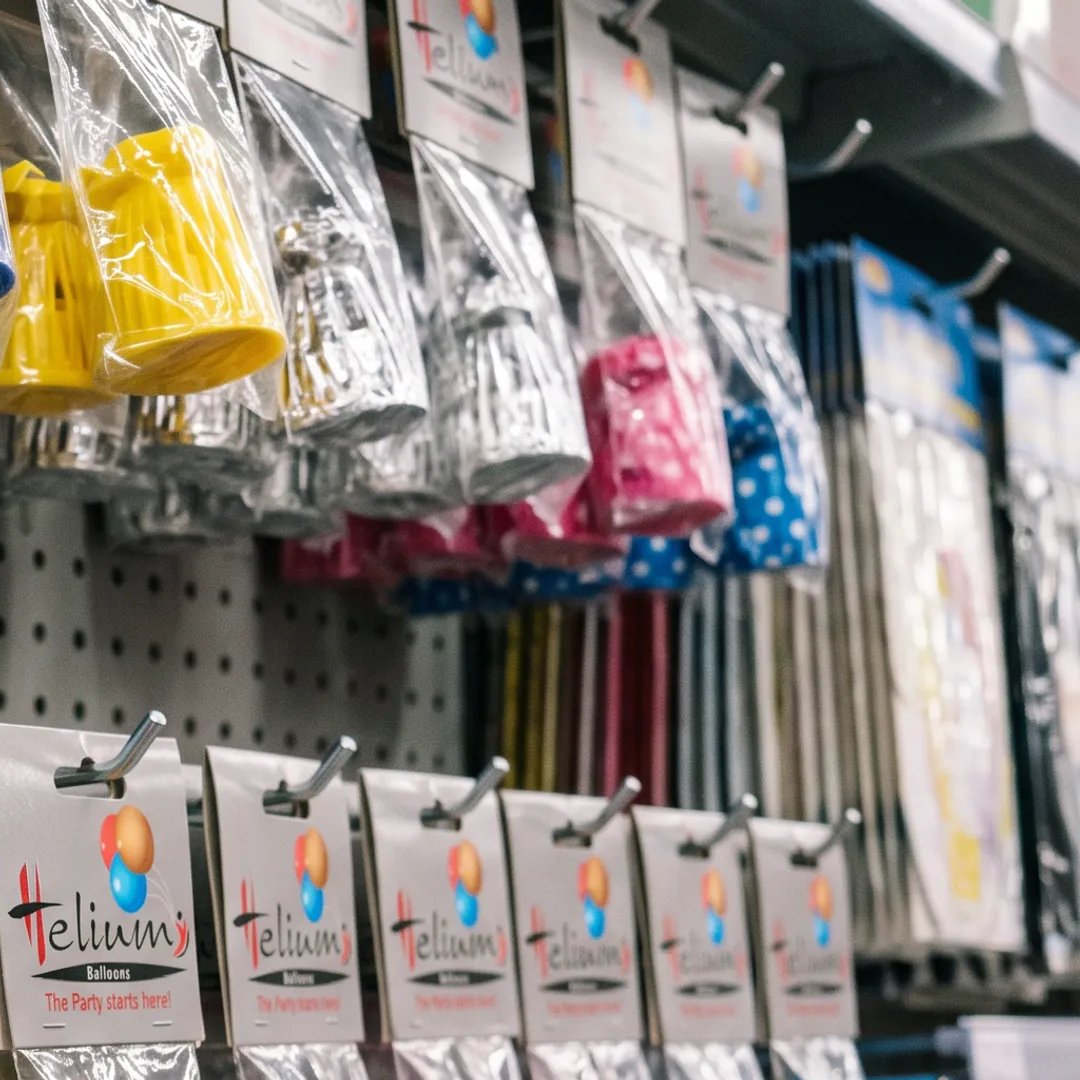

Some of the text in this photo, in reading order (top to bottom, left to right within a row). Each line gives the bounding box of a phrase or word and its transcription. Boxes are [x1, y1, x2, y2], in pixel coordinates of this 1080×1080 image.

[86, 965, 131, 981] Balloons
[45, 990, 172, 1016] The Party starts here!
